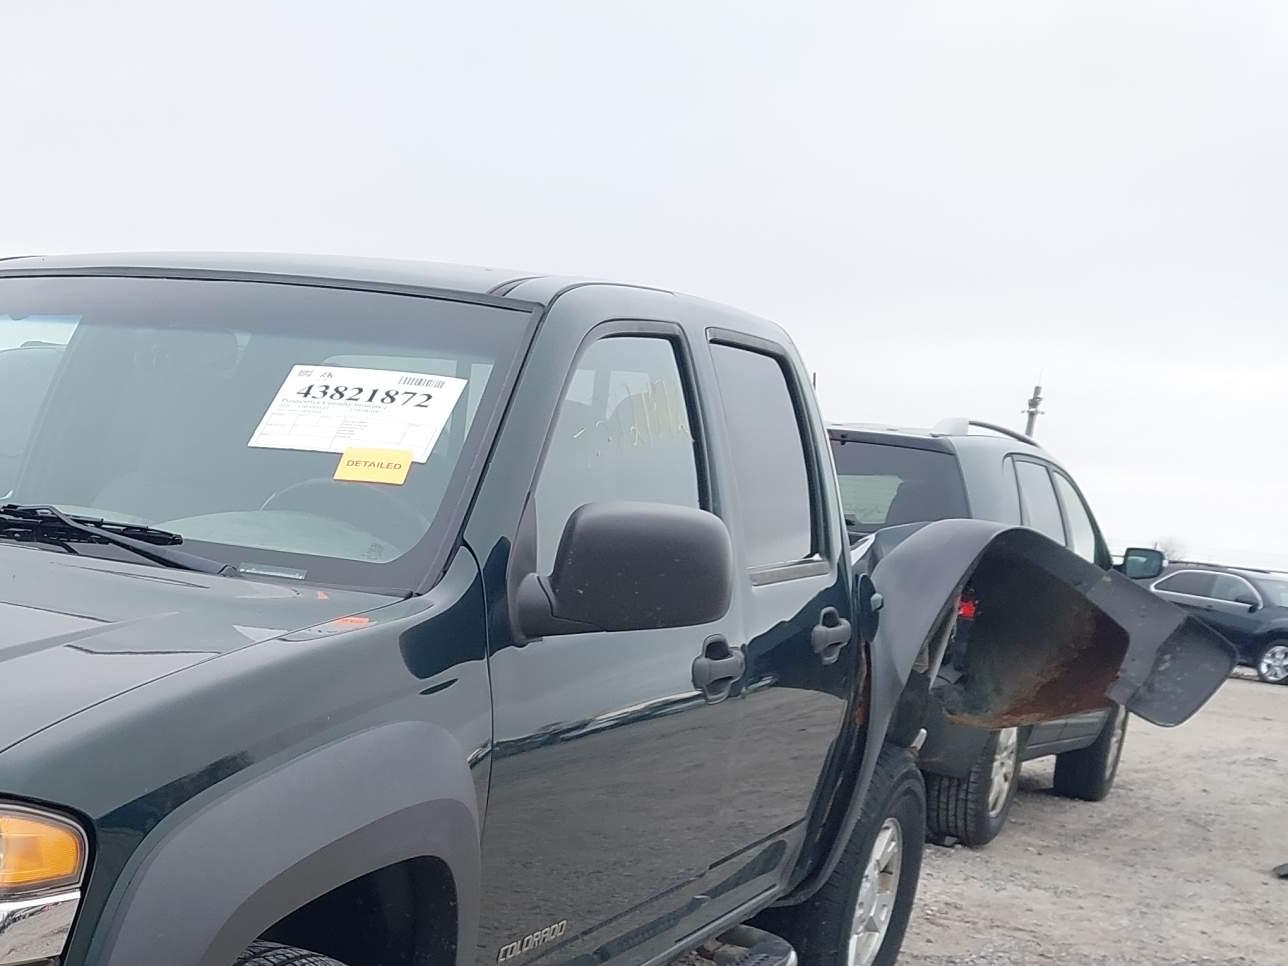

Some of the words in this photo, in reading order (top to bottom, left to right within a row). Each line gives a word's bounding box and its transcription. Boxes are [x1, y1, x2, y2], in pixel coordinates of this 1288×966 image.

[296, 383, 433, 408] 43821872
[346, 459, 402, 471] DETAILED
[497, 919, 568, 962] COLORADO
